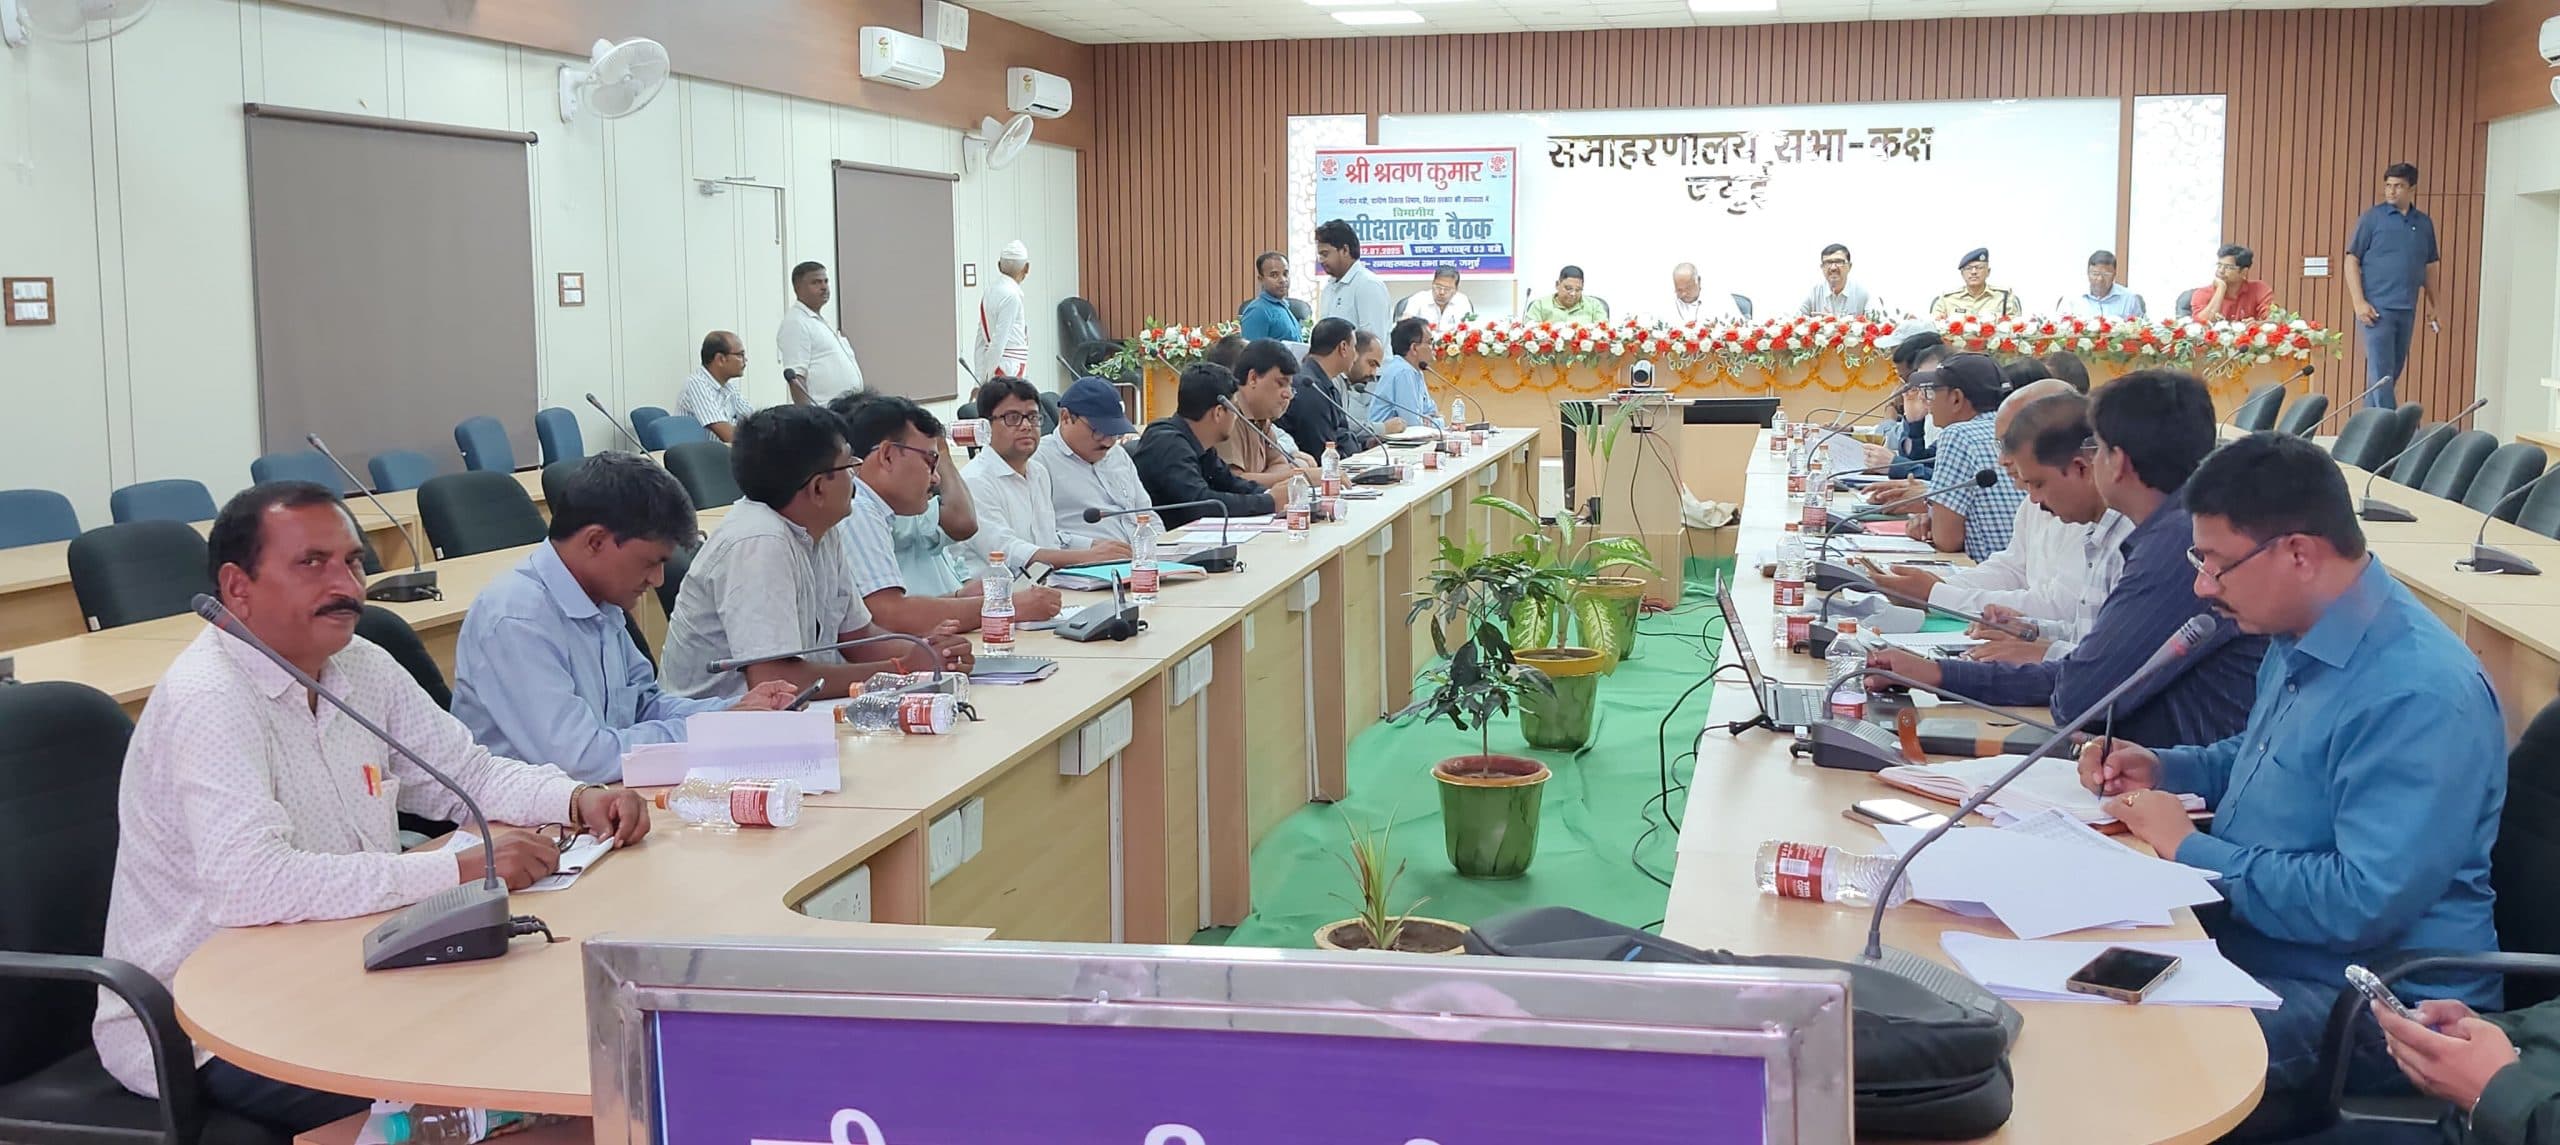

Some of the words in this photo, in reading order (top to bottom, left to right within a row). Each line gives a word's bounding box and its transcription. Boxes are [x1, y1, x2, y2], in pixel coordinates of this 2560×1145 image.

[1344, 156, 1370, 184] श्री
[1374, 162, 1423, 184] श्रवण
[1426, 161, 1483, 190] कुमार
[1444, 211, 1494, 240] बैठक
